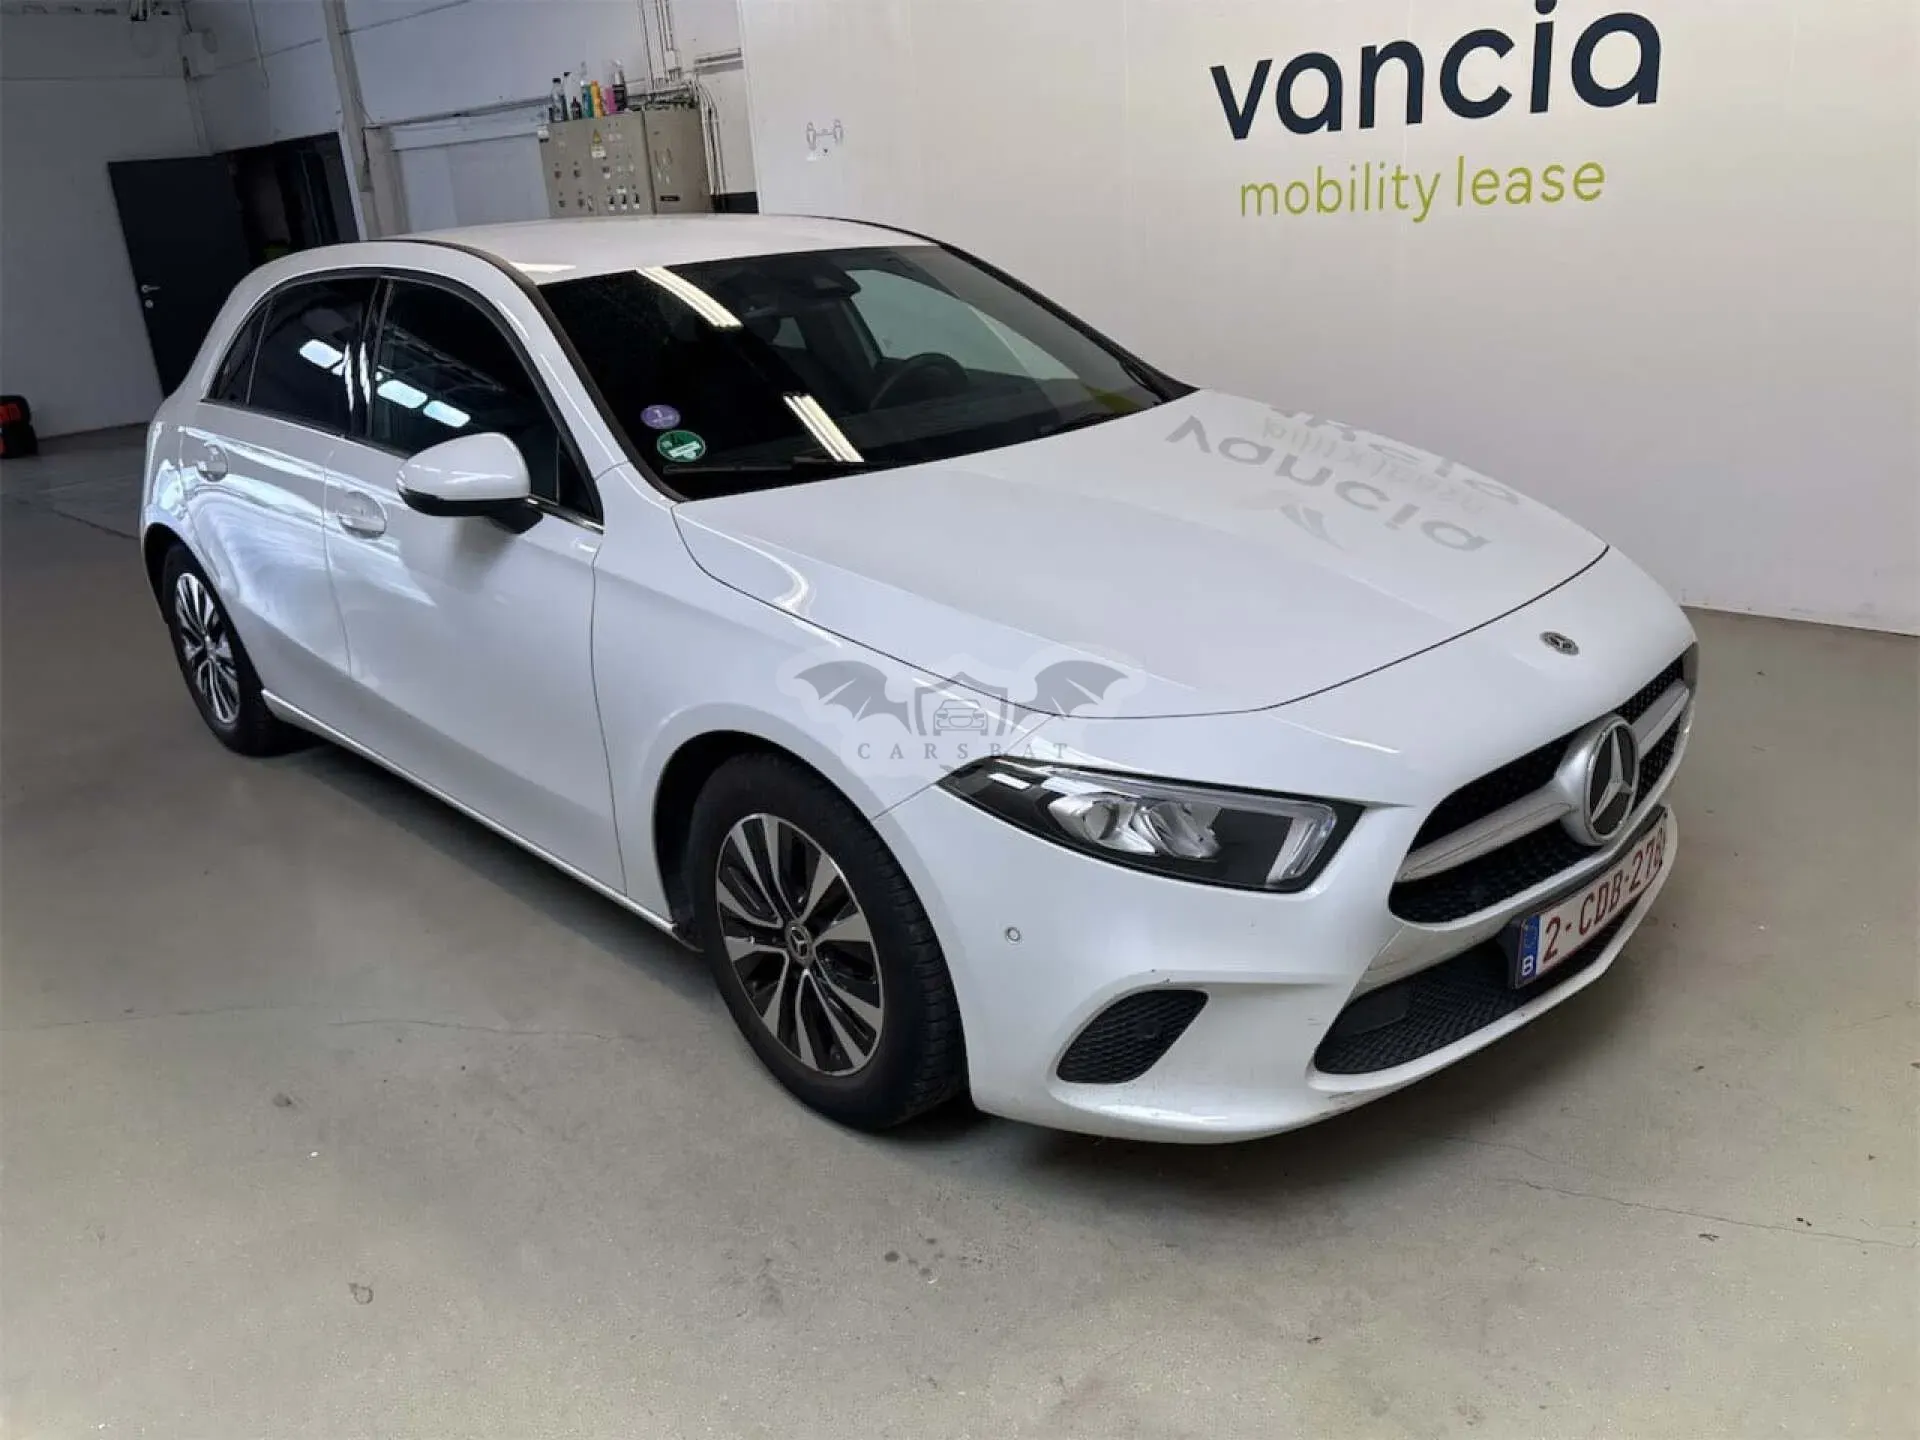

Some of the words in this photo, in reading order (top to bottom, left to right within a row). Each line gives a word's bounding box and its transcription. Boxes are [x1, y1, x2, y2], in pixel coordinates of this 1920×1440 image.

[1211, 0, 1661, 140] vancia
[1240, 162, 1441, 222] mobility
[1457, 156, 1606, 207] lease
[1521, 955, 1534, 976] B
